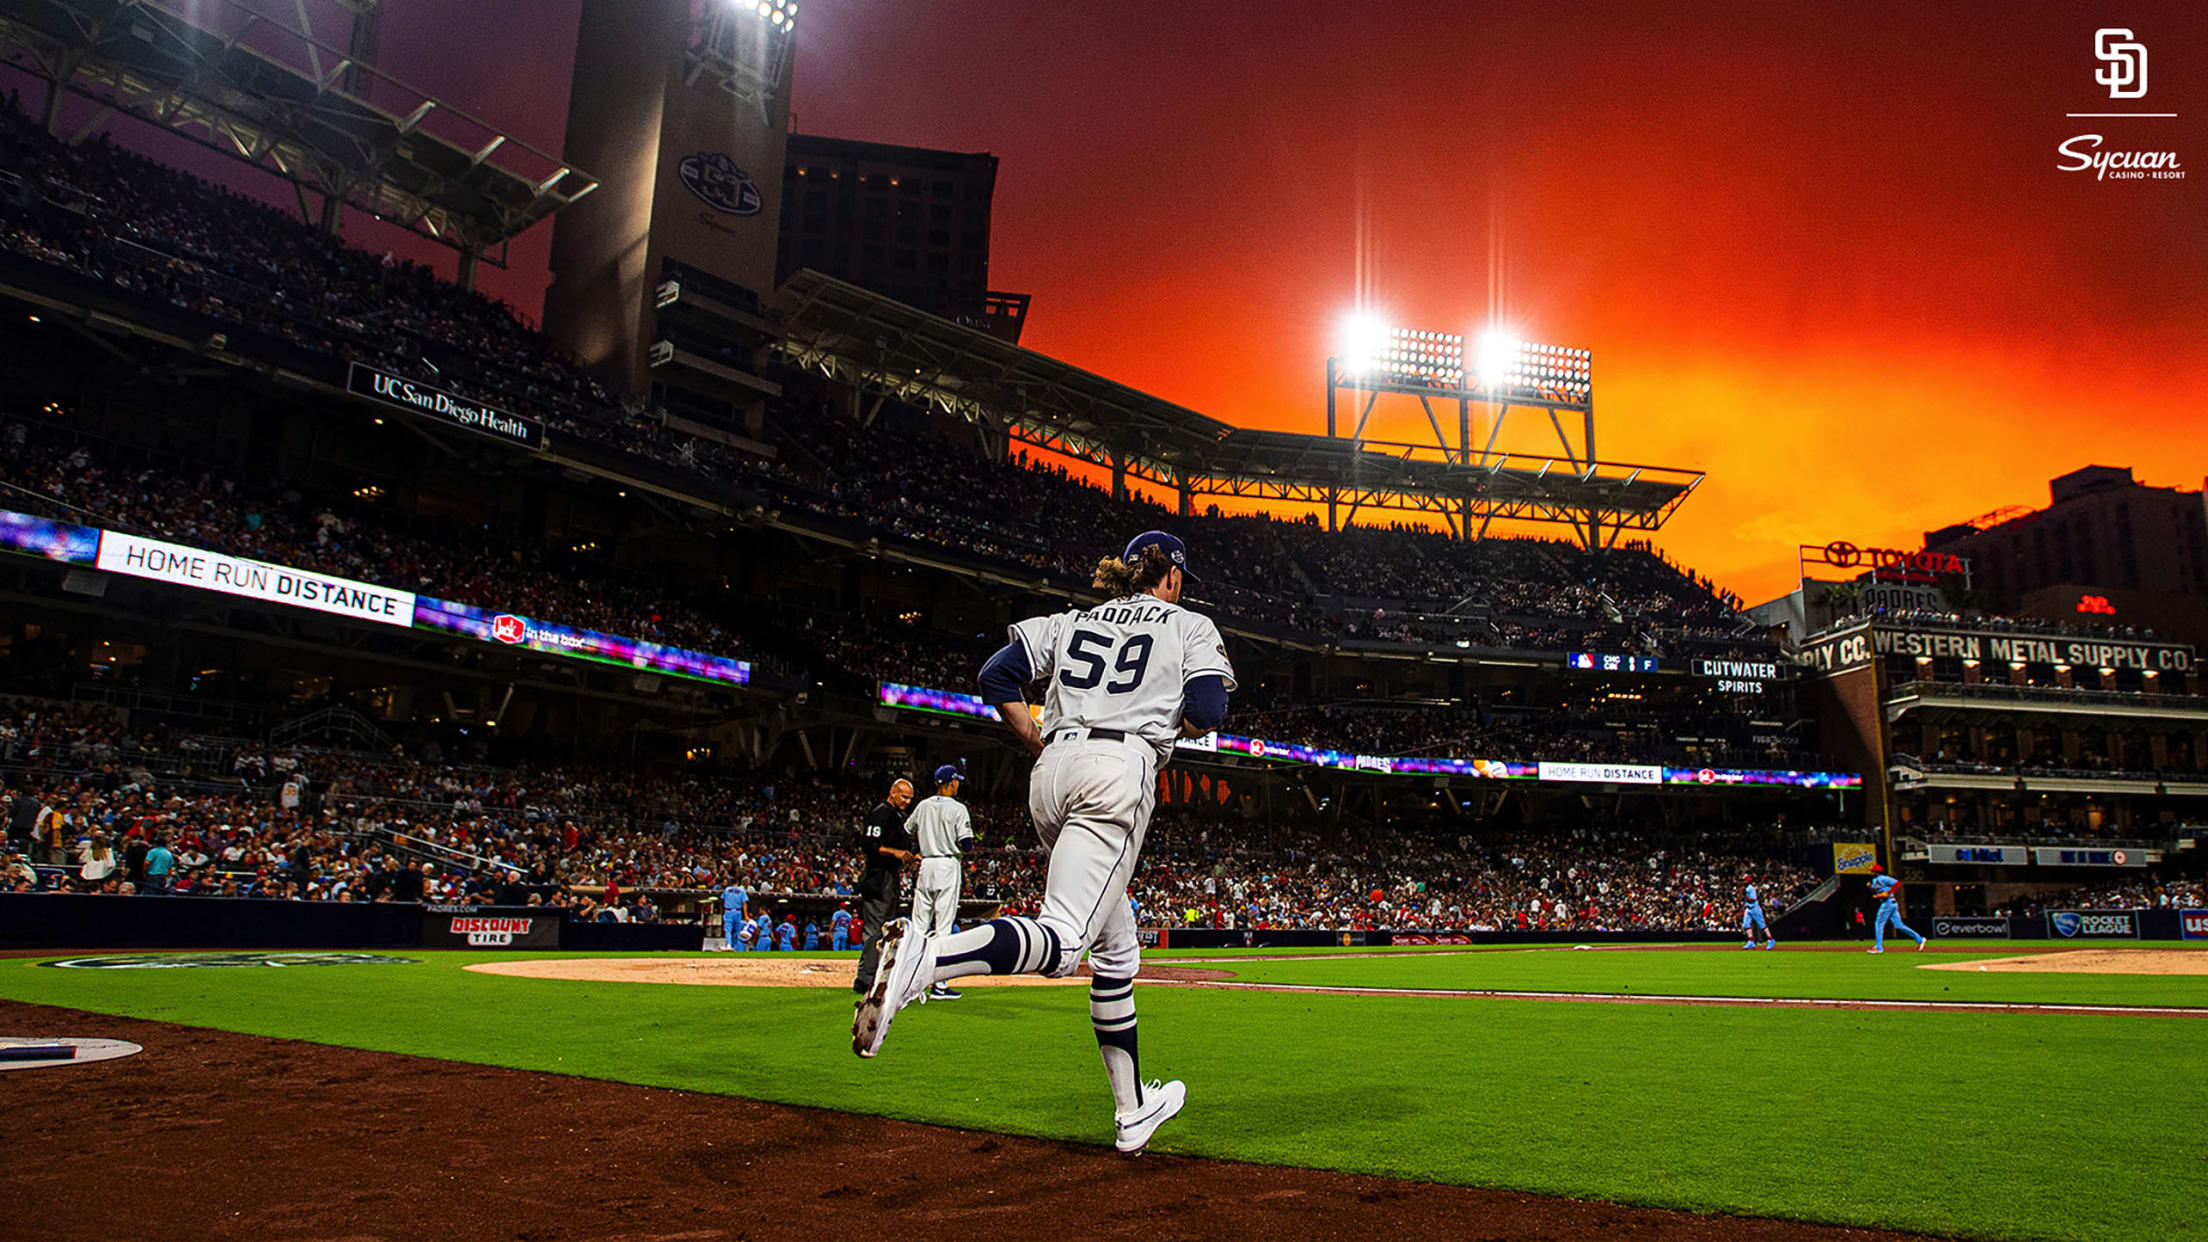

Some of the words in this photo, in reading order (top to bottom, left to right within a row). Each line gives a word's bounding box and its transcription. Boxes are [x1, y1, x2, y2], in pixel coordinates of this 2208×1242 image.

[374, 373, 402, 400] UC
[402, 383, 434, 410] San
[434, 393, 479, 425] Diego
[480, 407, 528, 439] Health
[1867, 546, 1964, 574] TOYOTA
[127, 545, 206, 579] HOME
[214, 562, 269, 591] RUN
[276, 574, 398, 616] DISTANCE
[1073, 605, 1179, 625] PADDACK
[1839, 634, 1871, 666] CO.
[1873, 630, 1981, 660] WESTERN
[1990, 637, 2065, 664] METAL
[2068, 643, 2149, 669] SUPPLY
[2158, 650, 2194, 671] CO.
[1059, 629, 1154, 695] 59
[1644, 660, 1652, 670] F
[1703, 660, 1777, 678] CUTWATER
[1718, 680, 1763, 693] SPIRITS
[1356, 755, 1392, 774] PADRES
[1548, 766, 1578, 778] HOME
[1580, 768, 1601, 779] RUN
[1603, 768, 1655, 780] DISTANCE
[866, 825, 881, 837] 19
[450, 917, 533, 934] DISCOUNT
[1951, 922, 2008, 934] everbowl
[2082, 915, 2131, 925] ROCKET
[2083, 924, 2133, 934] LEAGUE
[473, 934, 507, 943] TIRE
